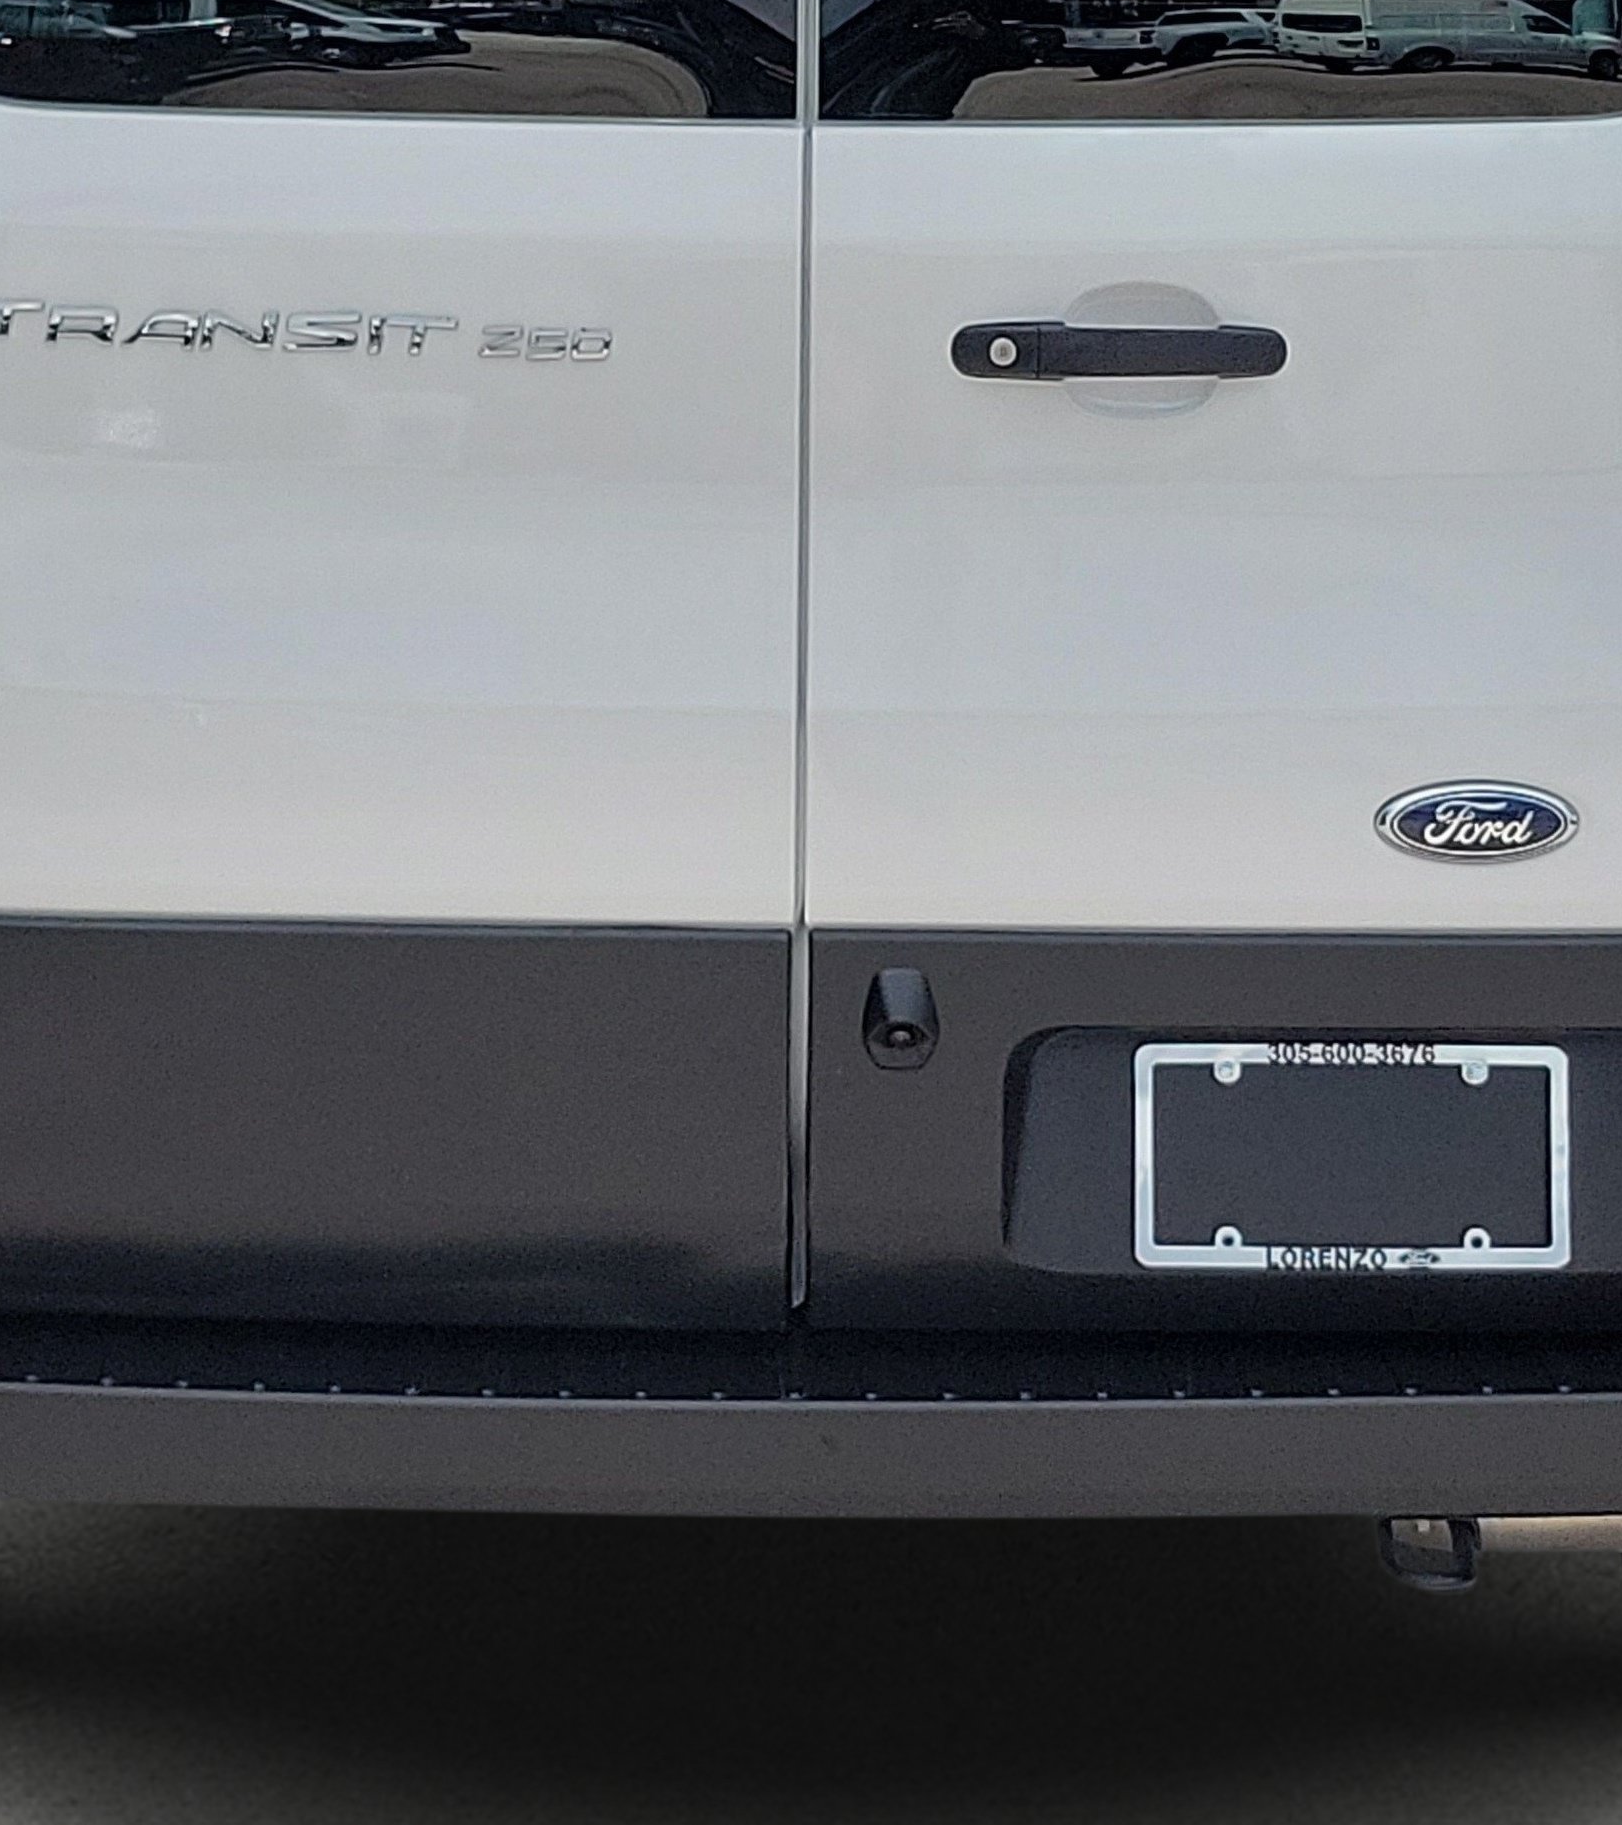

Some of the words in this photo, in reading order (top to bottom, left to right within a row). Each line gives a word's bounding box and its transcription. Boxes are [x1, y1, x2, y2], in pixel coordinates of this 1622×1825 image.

[478, 323, 613, 362] 250
[1423, 799, 1535, 846] Ford
[1267, 1043, 1435, 1066] 305-600-3676
[1266, 1245, 1387, 1271] LORENZO
